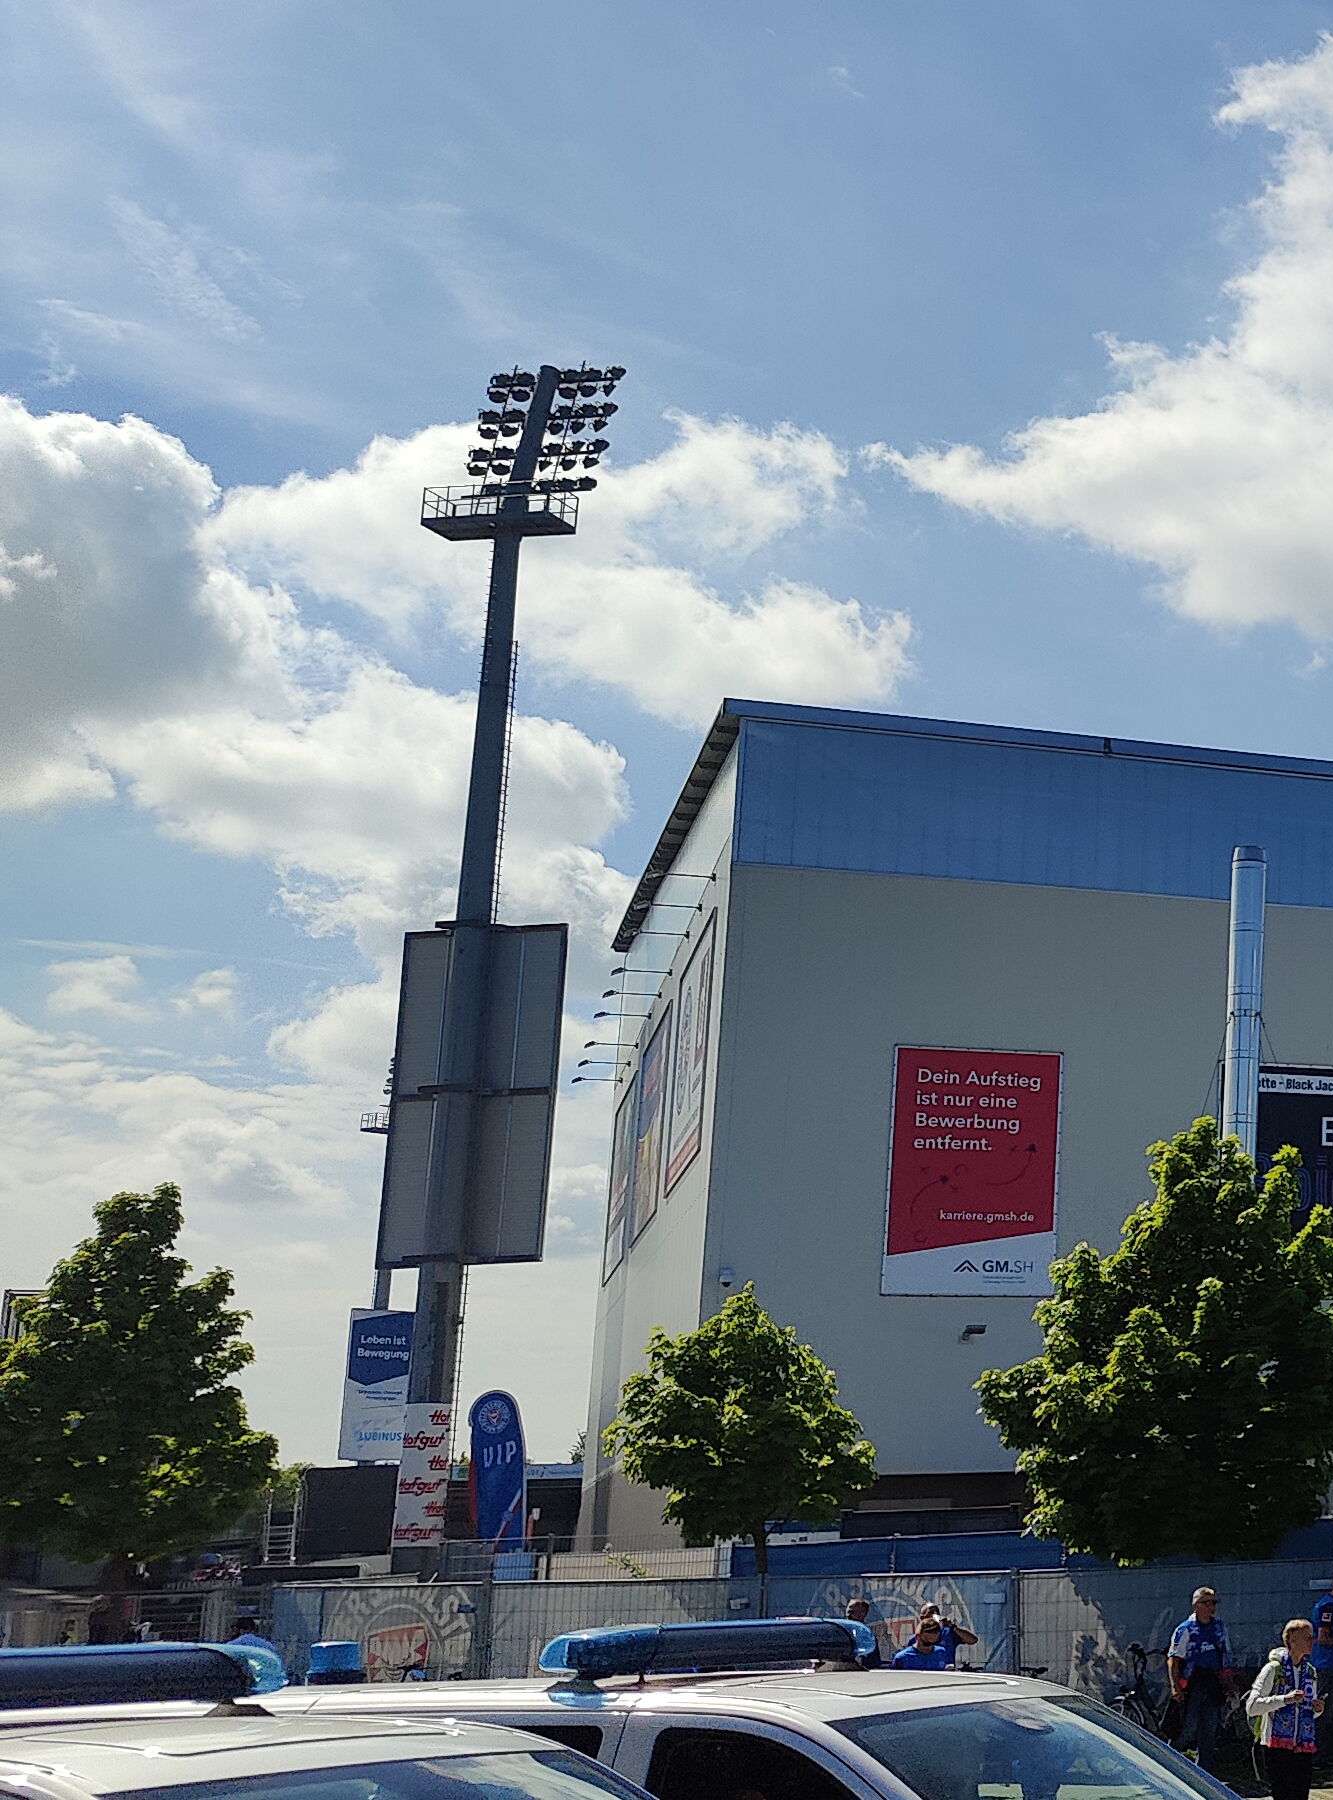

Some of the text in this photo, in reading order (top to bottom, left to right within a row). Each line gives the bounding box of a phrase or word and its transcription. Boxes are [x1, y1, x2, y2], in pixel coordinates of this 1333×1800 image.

[917, 1068, 1042, 1092] Dein Aufstieg
[1286, 1079, 1313, 1091] Black
[916, 1090, 1018, 1109] ist nur eine
[915, 1112, 1020, 1134] Bewerbung
[913, 1136, 993, 1151] entfernt.
[939, 1209, 1035, 1223] karriere.gmsh.de
[982, 1260, 1034, 1274] GM.SH
[361, 1335, 406, 1345] Leben ist
[357, 1348, 409, 1361] Bewegung
[483, 1440, 517, 1468] VIP
